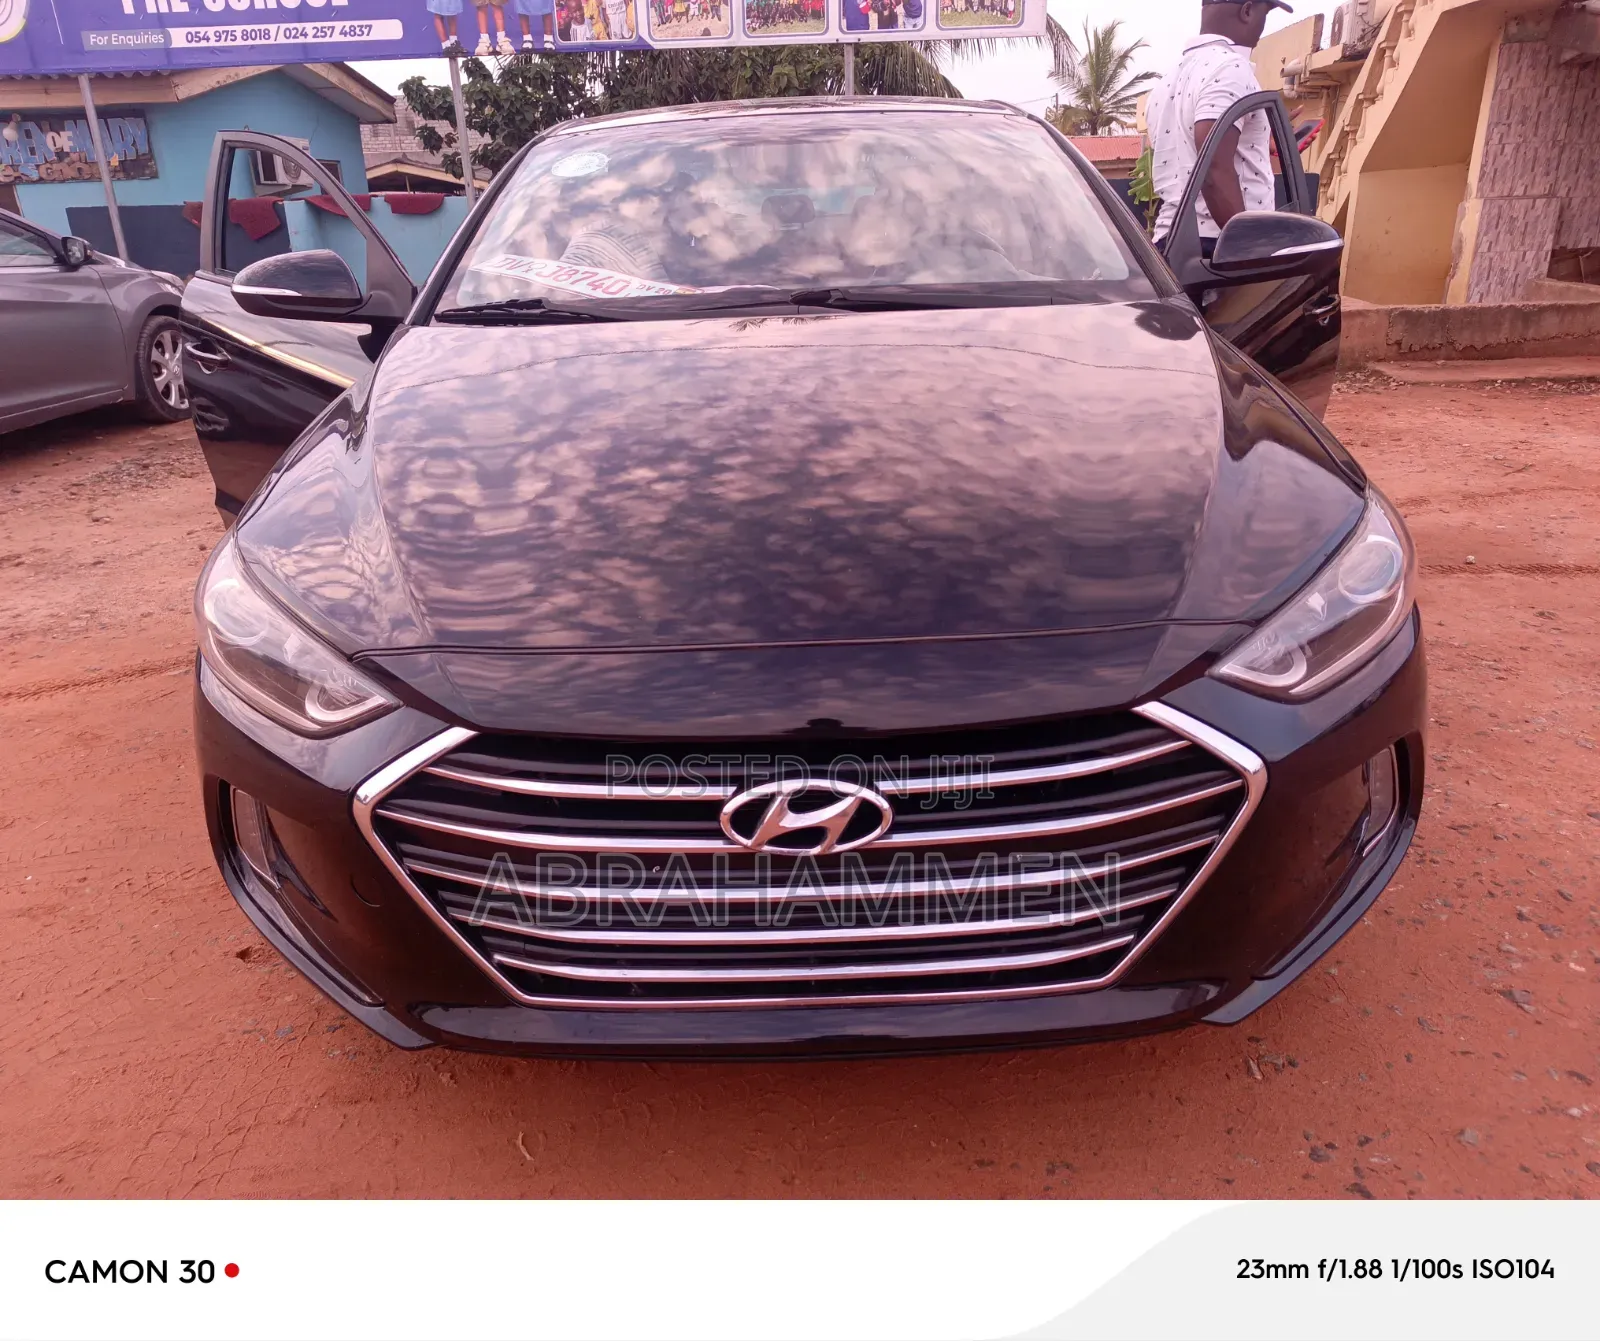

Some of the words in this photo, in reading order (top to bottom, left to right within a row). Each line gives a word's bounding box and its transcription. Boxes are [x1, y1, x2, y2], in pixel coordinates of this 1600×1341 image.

[90, 34, 108, 46] For
[112, 33, 165, 47] Enquiries
[185, 30, 210, 44] 054
[214, 30, 237, 43] 975
[241, 28, 271, 42] 8018
[283, 27, 308, 40] 024
[312, 26, 336, 39] 257
[339, 24, 373, 38] 4837
[46, 131, 73, 152] OF
[64, 117, 149, 162] MARY
